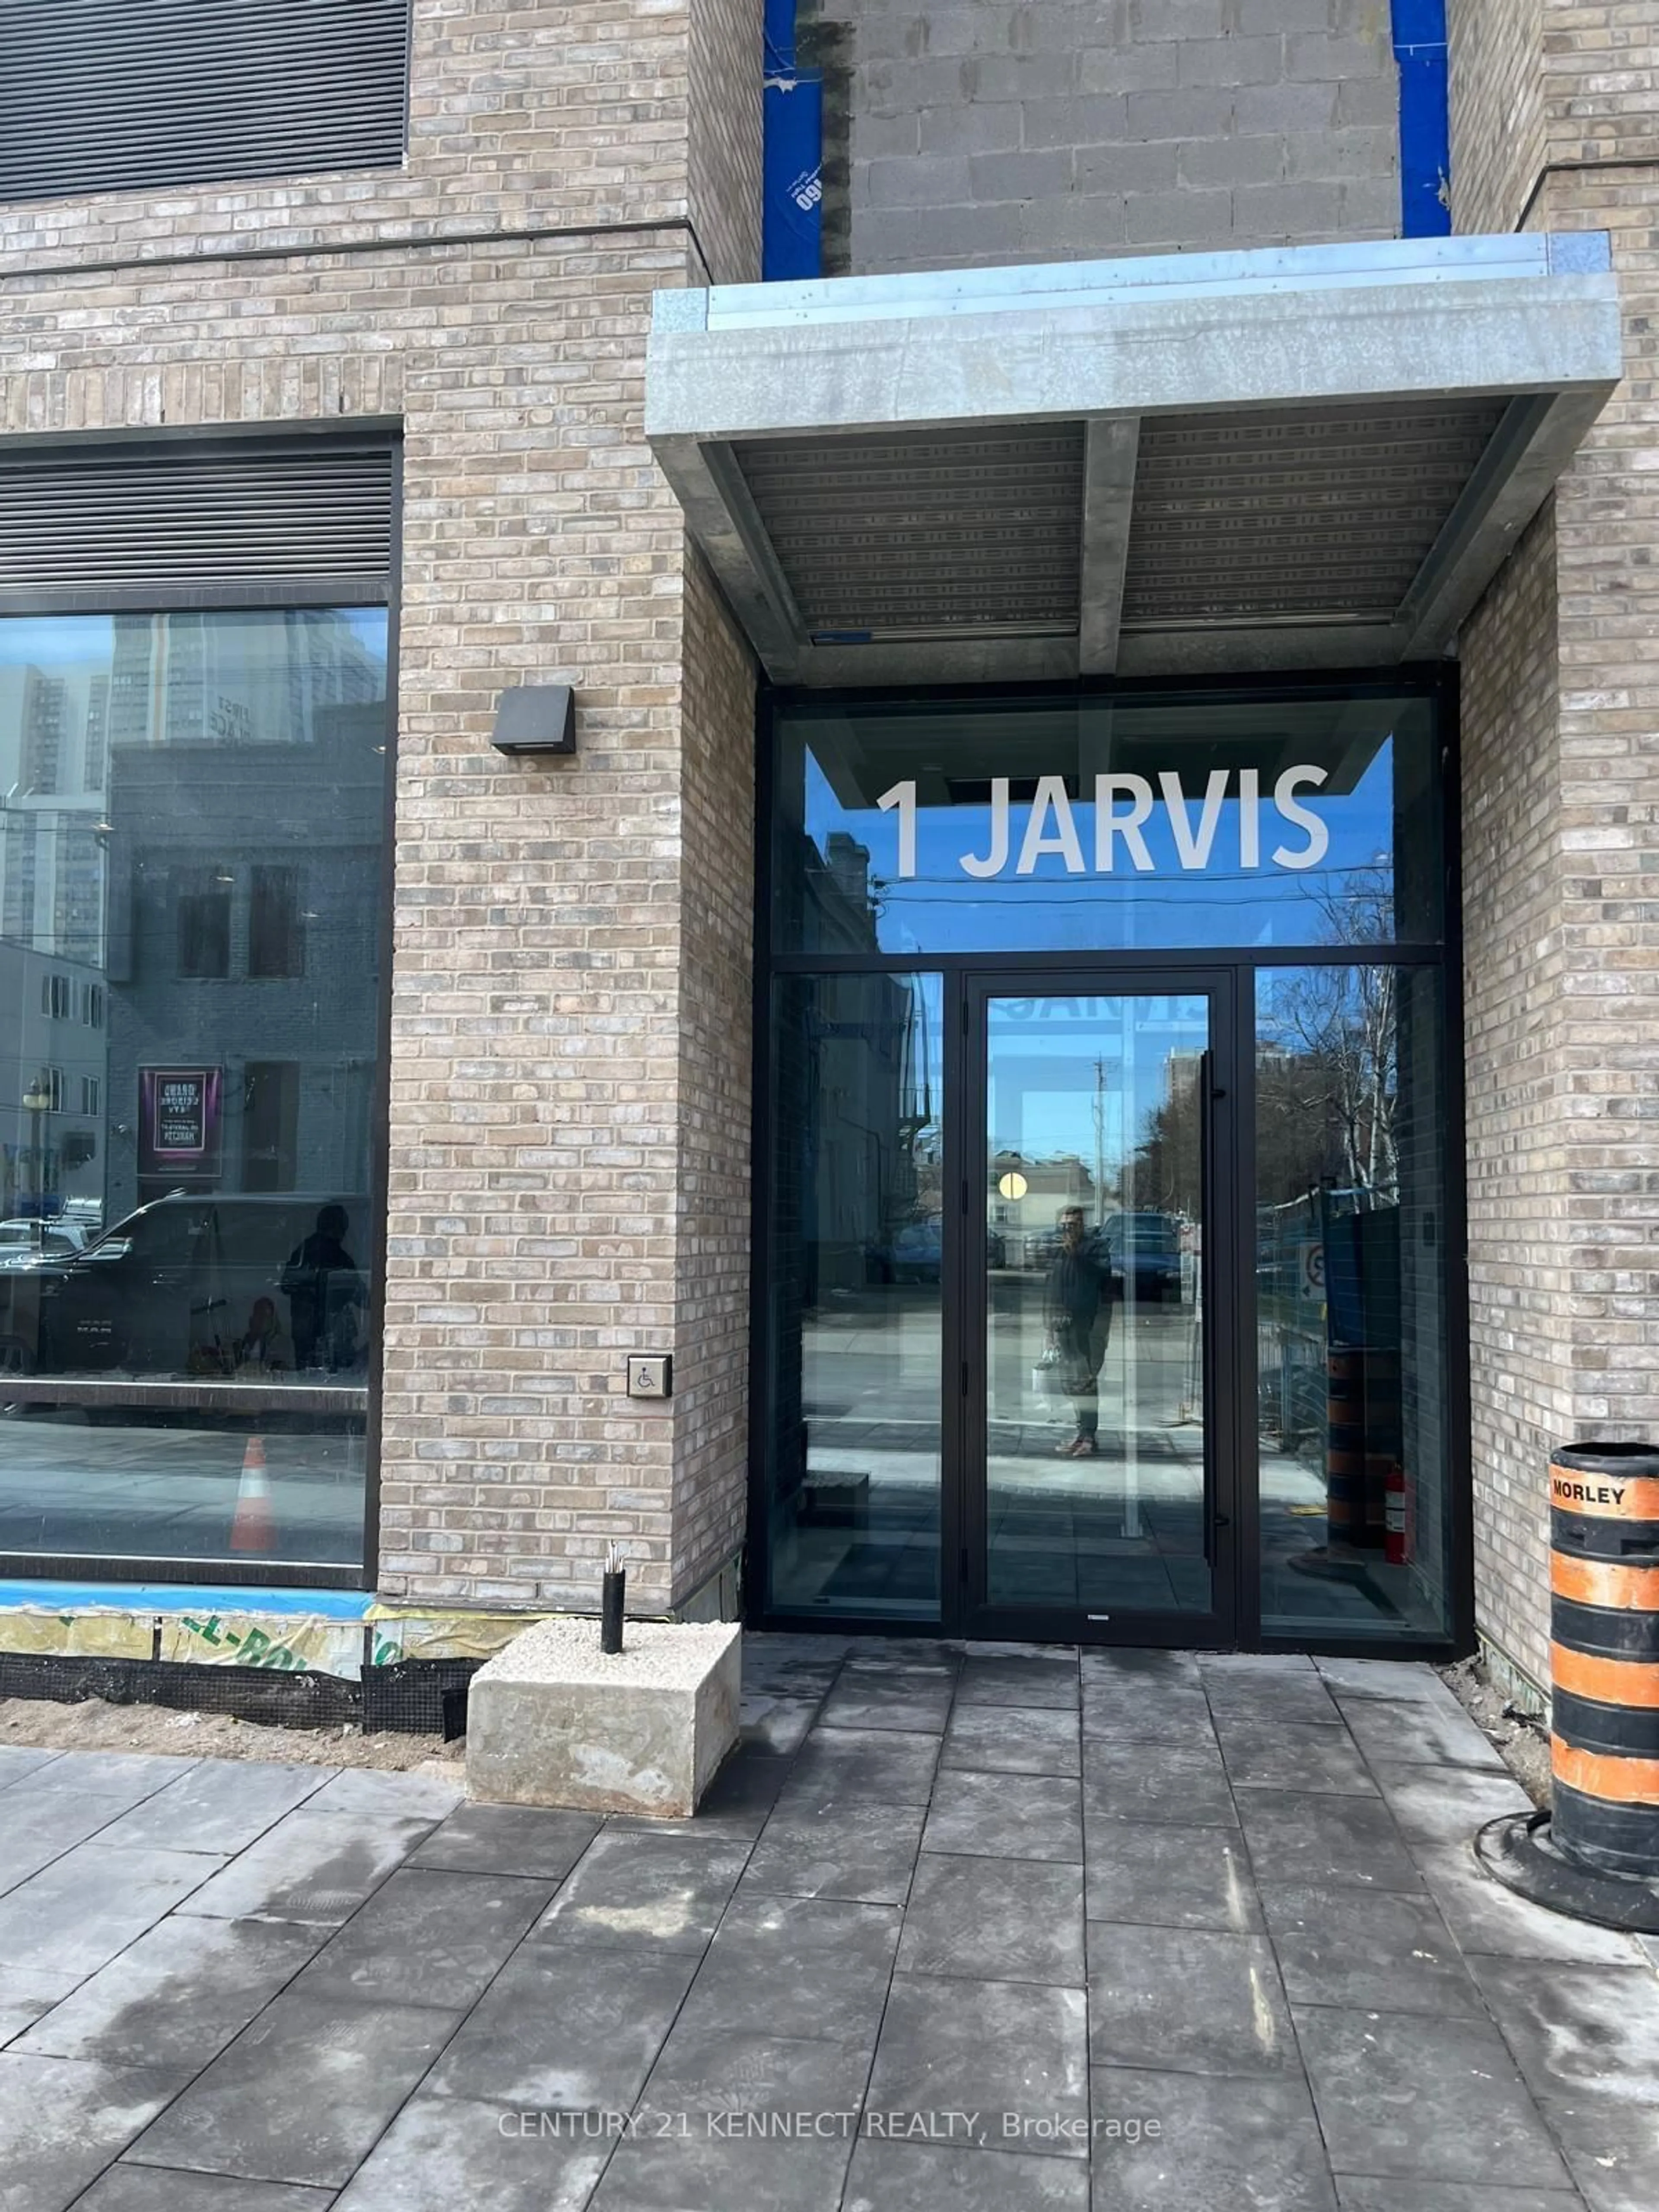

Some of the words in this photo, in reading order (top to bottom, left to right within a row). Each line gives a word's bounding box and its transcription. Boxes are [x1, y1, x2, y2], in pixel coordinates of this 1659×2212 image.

[876, 781, 916, 877] 1
[959, 764, 1330, 878] JARVIS
[1554, 1479, 1626, 1505] MORLEY
